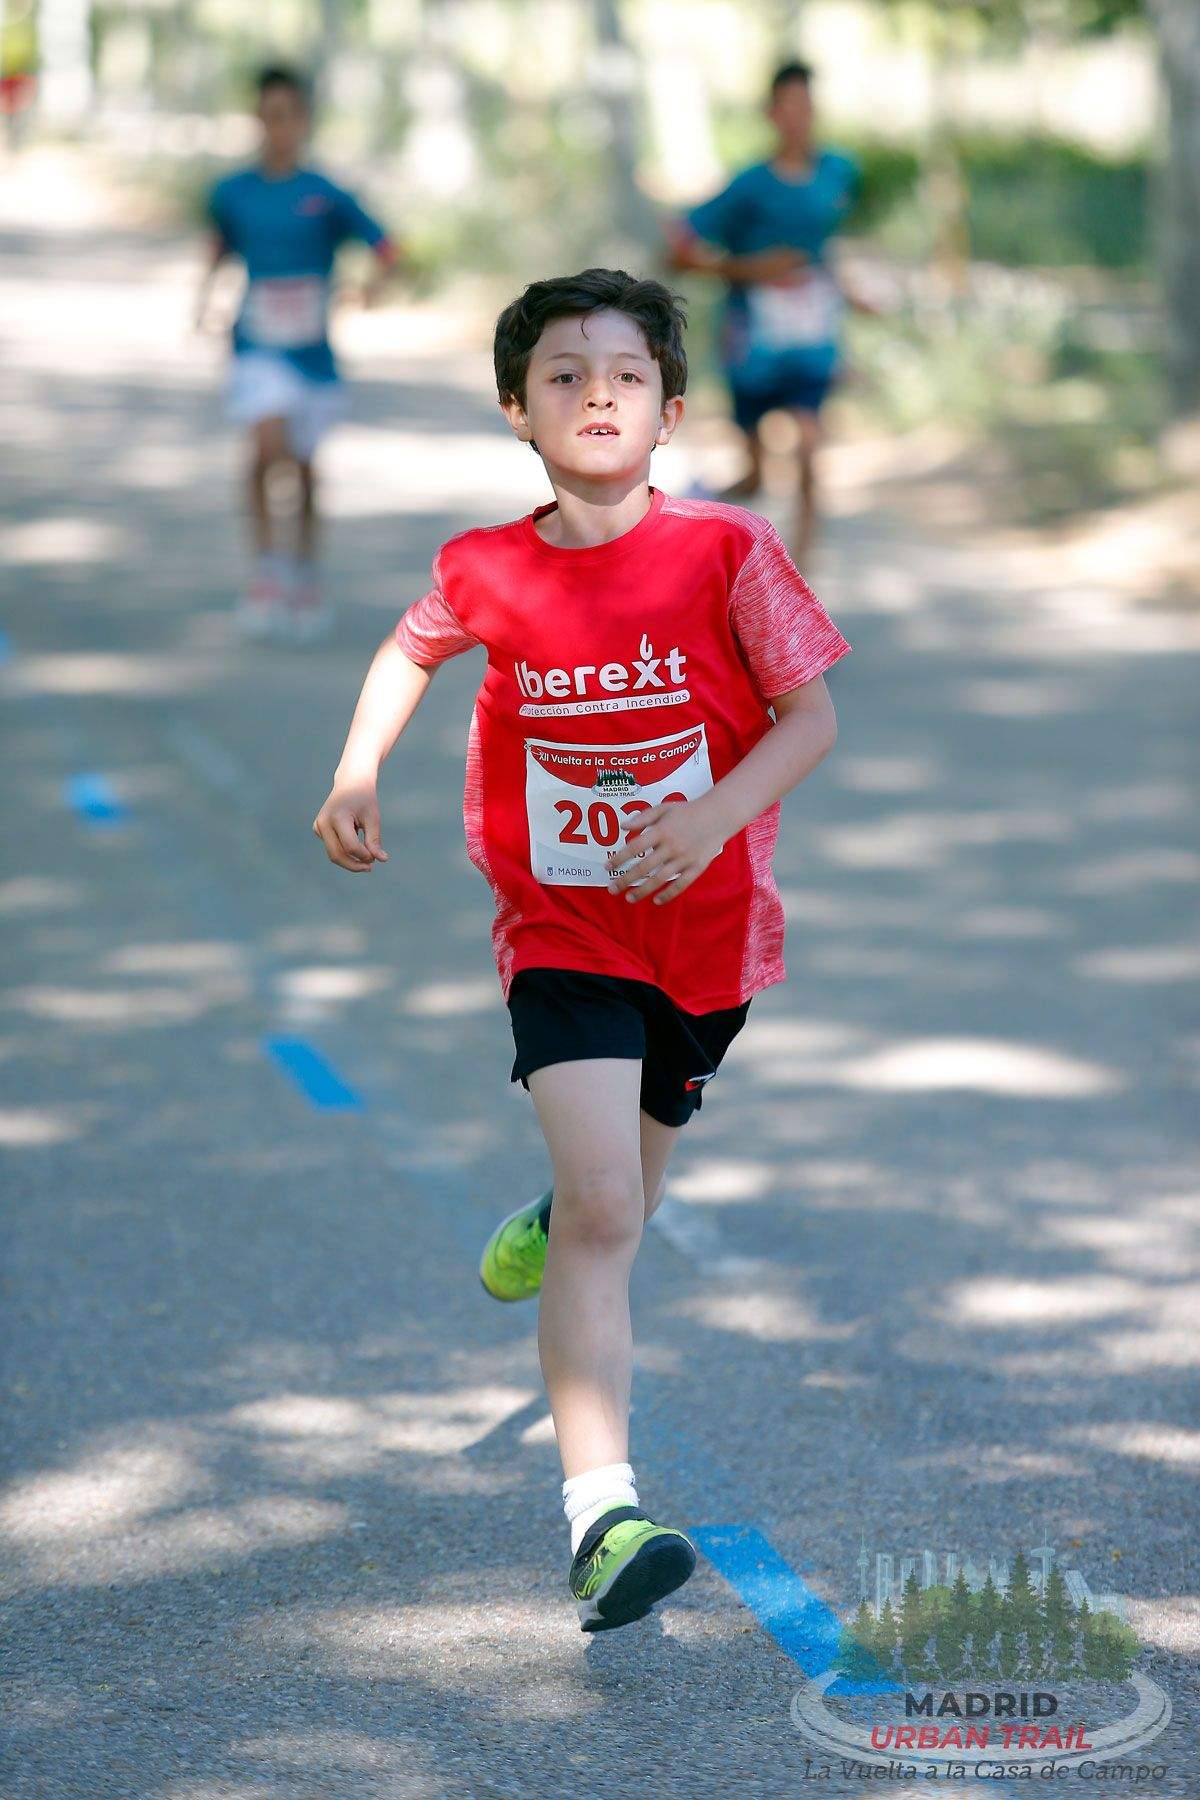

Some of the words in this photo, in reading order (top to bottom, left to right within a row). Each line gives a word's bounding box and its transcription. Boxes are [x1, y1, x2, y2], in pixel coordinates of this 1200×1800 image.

[514, 646, 687, 698] Iberext
[576, 702, 619, 713] Contra
[626, 693, 688, 708] Incendios
[551, 753, 582, 766] Vuelta
[584, 758, 592, 766] a
[594, 756, 605, 766] la
[610, 757, 638, 766] Casa
[641, 753, 656, 763] de
[659, 741, 695, 759] Campo
[554, 791, 690, 847] 202
[558, 867, 592, 877] MADRID
